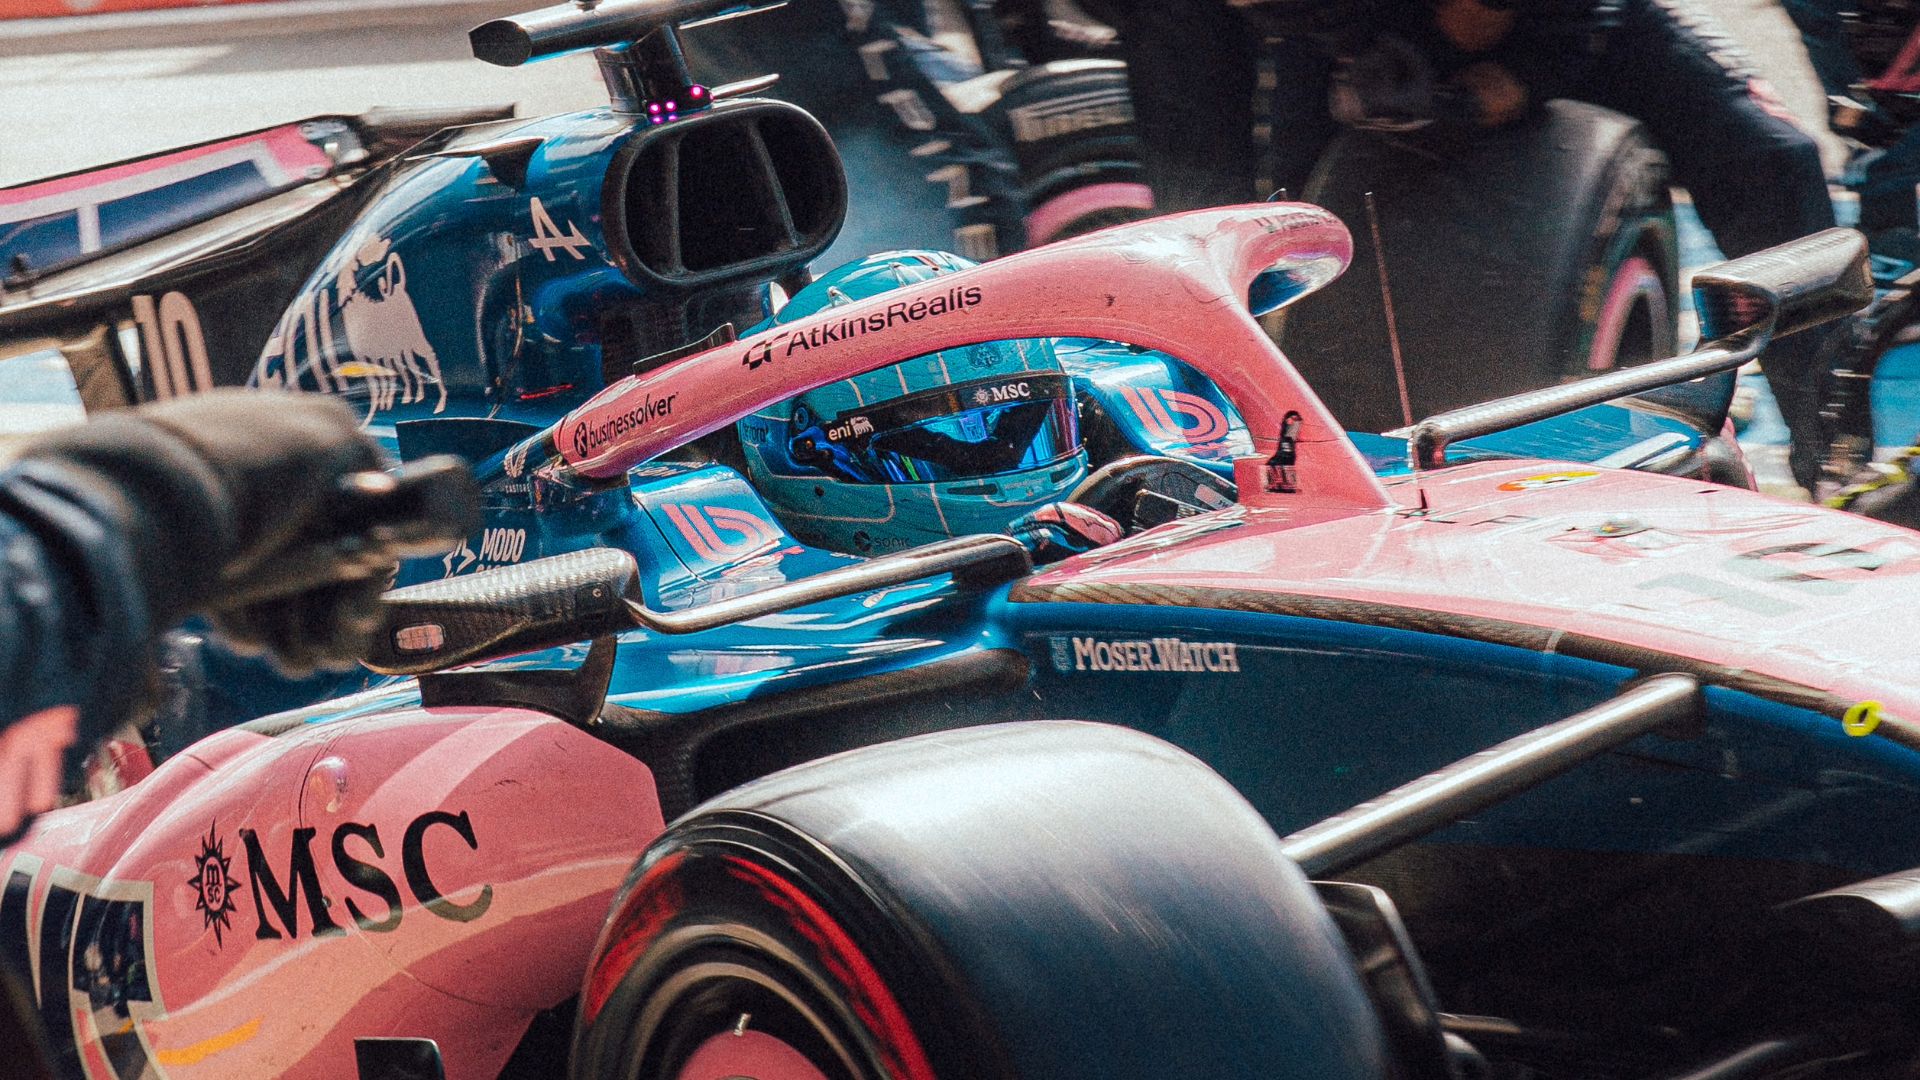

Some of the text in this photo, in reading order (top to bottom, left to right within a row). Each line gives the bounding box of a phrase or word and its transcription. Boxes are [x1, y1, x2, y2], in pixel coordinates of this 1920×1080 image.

[131, 291, 214, 400] 10
[786, 286, 982, 357] AtkinsRéalis
[990, 382, 1031, 402] MSC
[589, 393, 677, 449] businessolver
[828, 420, 853, 441] eni
[478, 527, 526, 564] MODO
[238, 810, 494, 940] MSC
